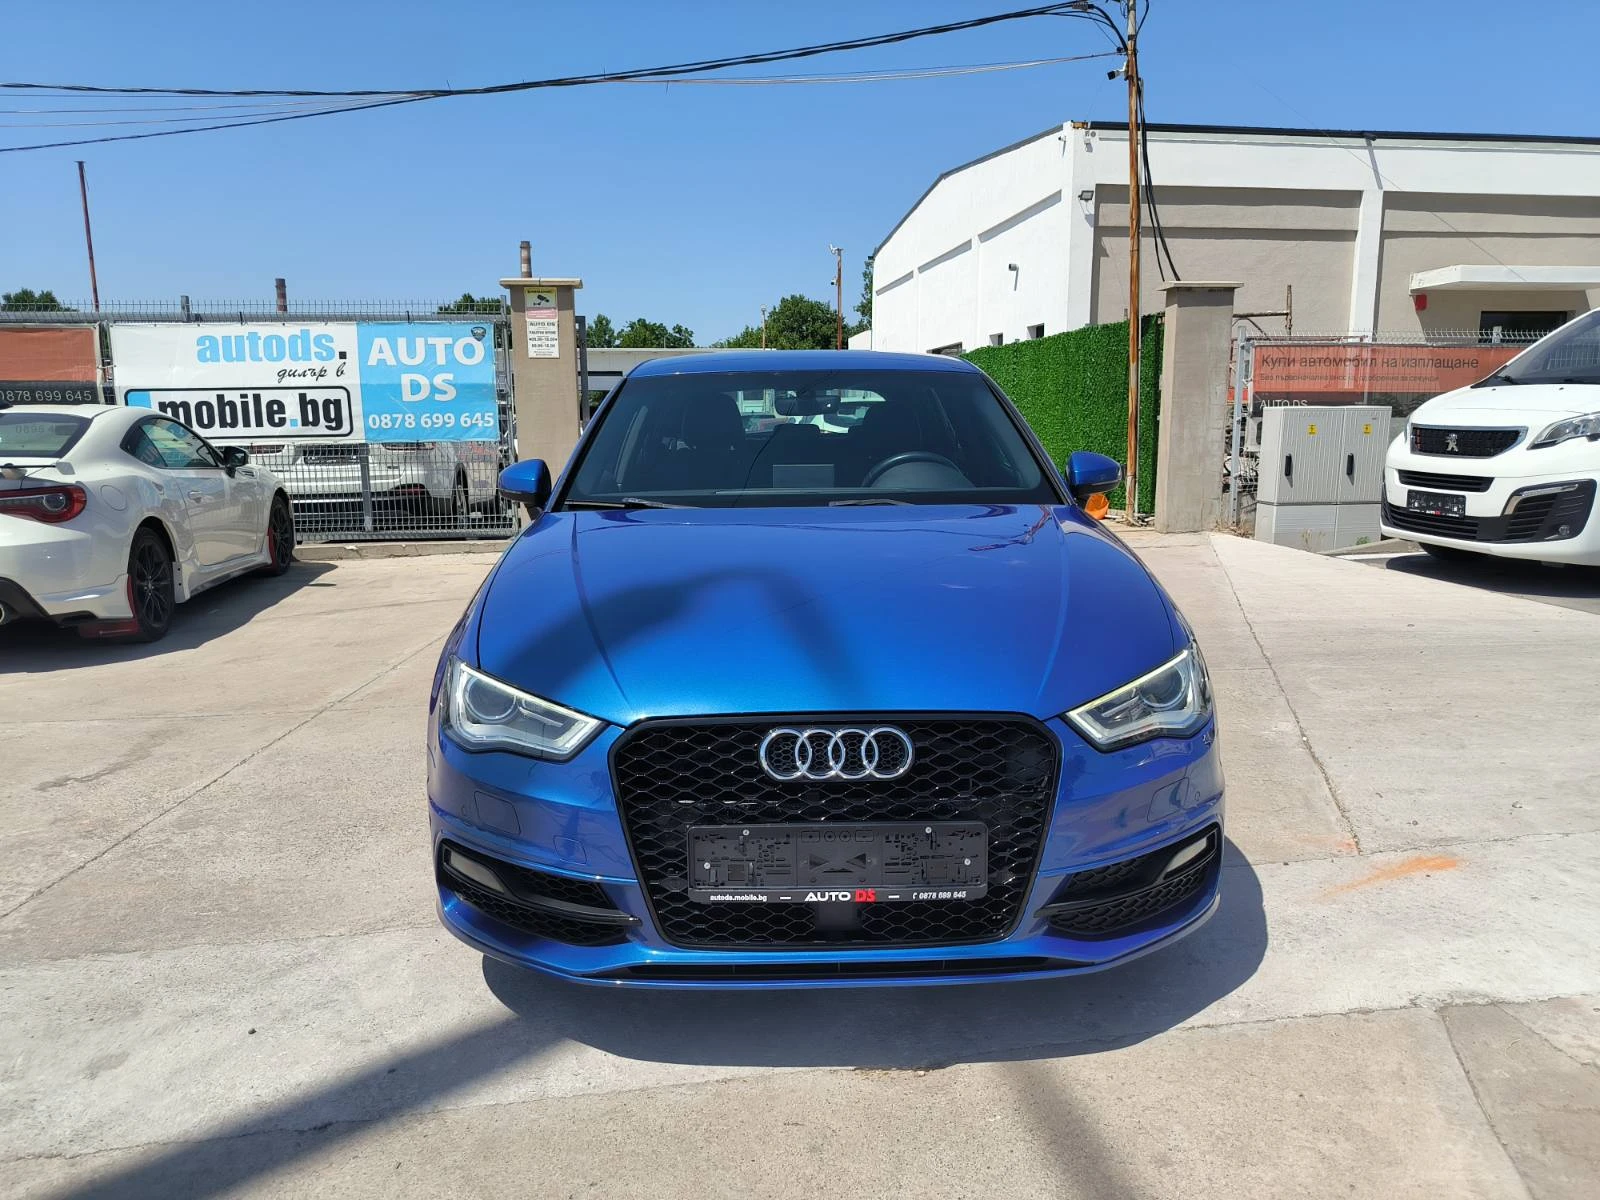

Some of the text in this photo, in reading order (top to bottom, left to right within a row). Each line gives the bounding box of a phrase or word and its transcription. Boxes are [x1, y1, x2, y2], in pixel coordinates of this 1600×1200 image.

[367, 336, 485, 366] AUTO
[1261, 354, 1480, 370] Купи автомобил на изплащане
[277, 366, 328, 384] дилър
[400, 372, 457, 402] DS
[35, 390, 62, 402] 699
[65, 390, 92, 402] 645
[1260, 399, 1290, 409] AUTO
[158, 392, 345, 432] mobile.bg
[368, 412, 495, 429] 0878 699 645
[804, 891, 851, 902] AUTO
[855, 889, 877, 903] DS
